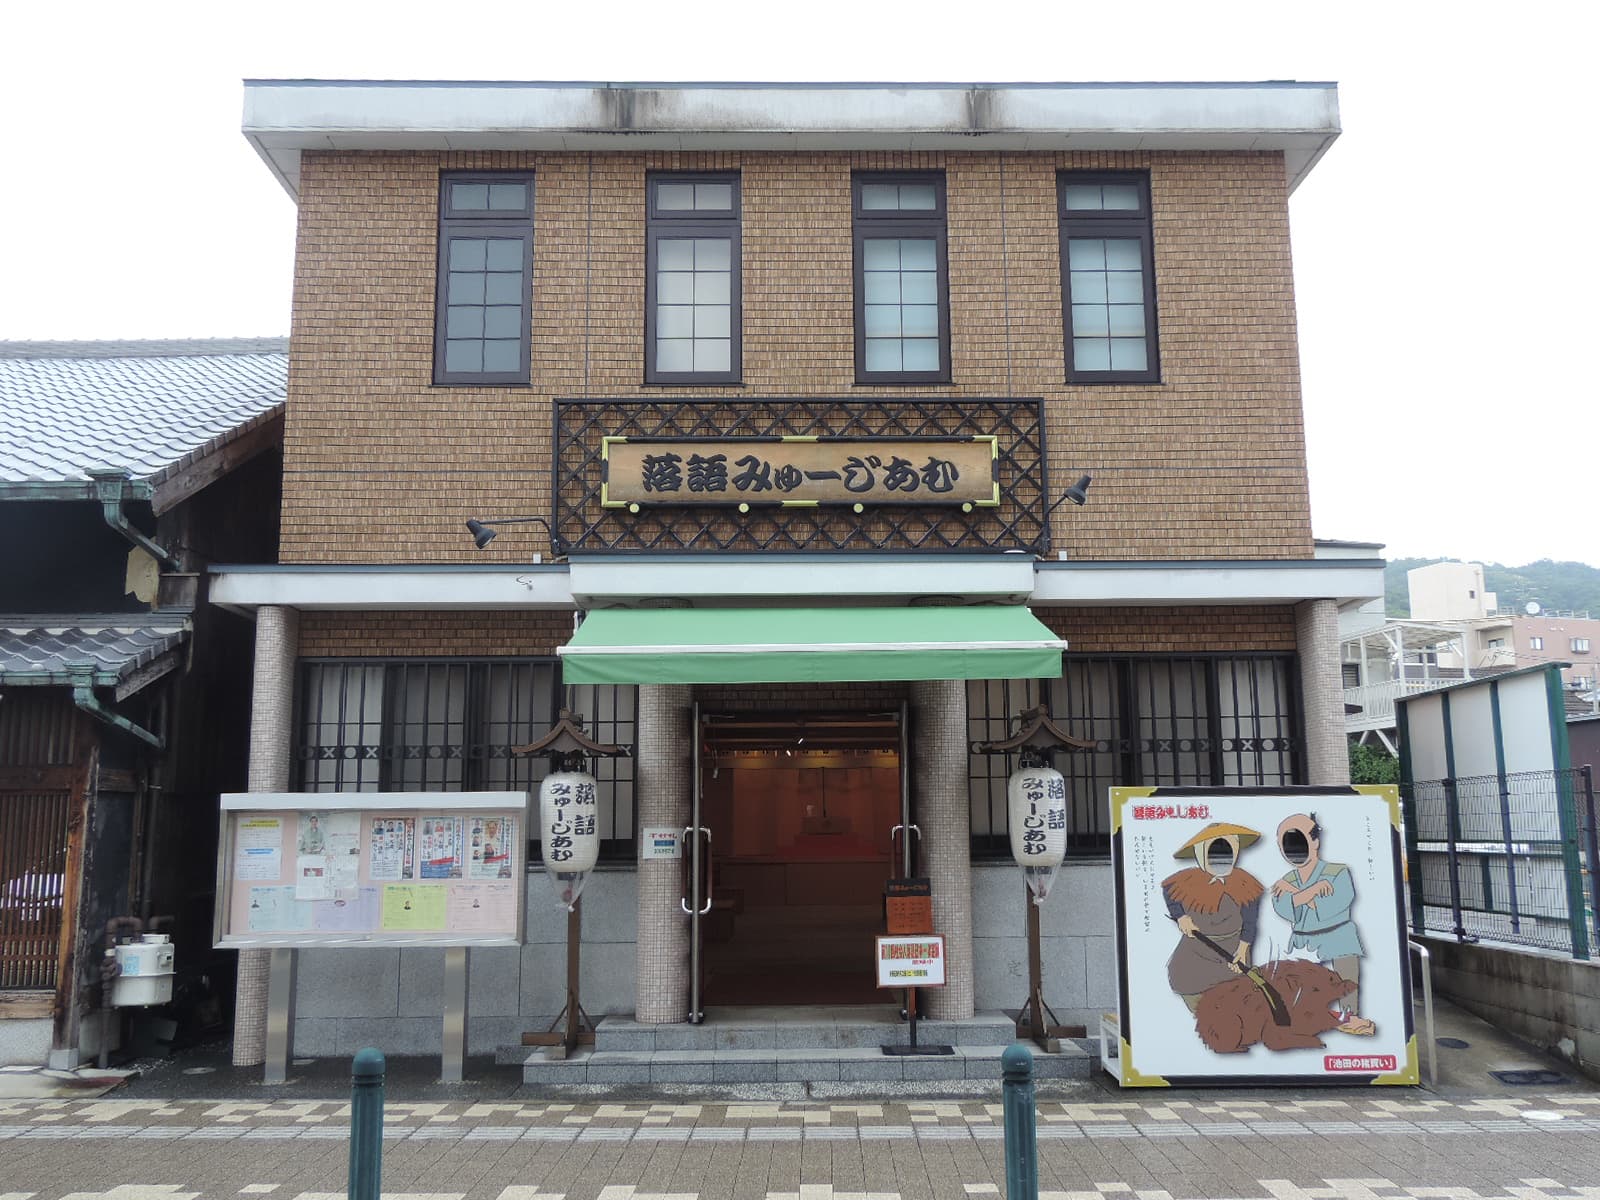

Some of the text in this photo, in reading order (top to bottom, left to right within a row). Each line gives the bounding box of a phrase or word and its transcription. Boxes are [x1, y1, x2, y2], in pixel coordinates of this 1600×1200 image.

[550, 782, 574, 862] みゅーじあむ
[575, 782, 596, 836] 落語
[1022, 777, 1047, 855] みゅーじあむ
[1047, 777, 1065, 830] 落語
